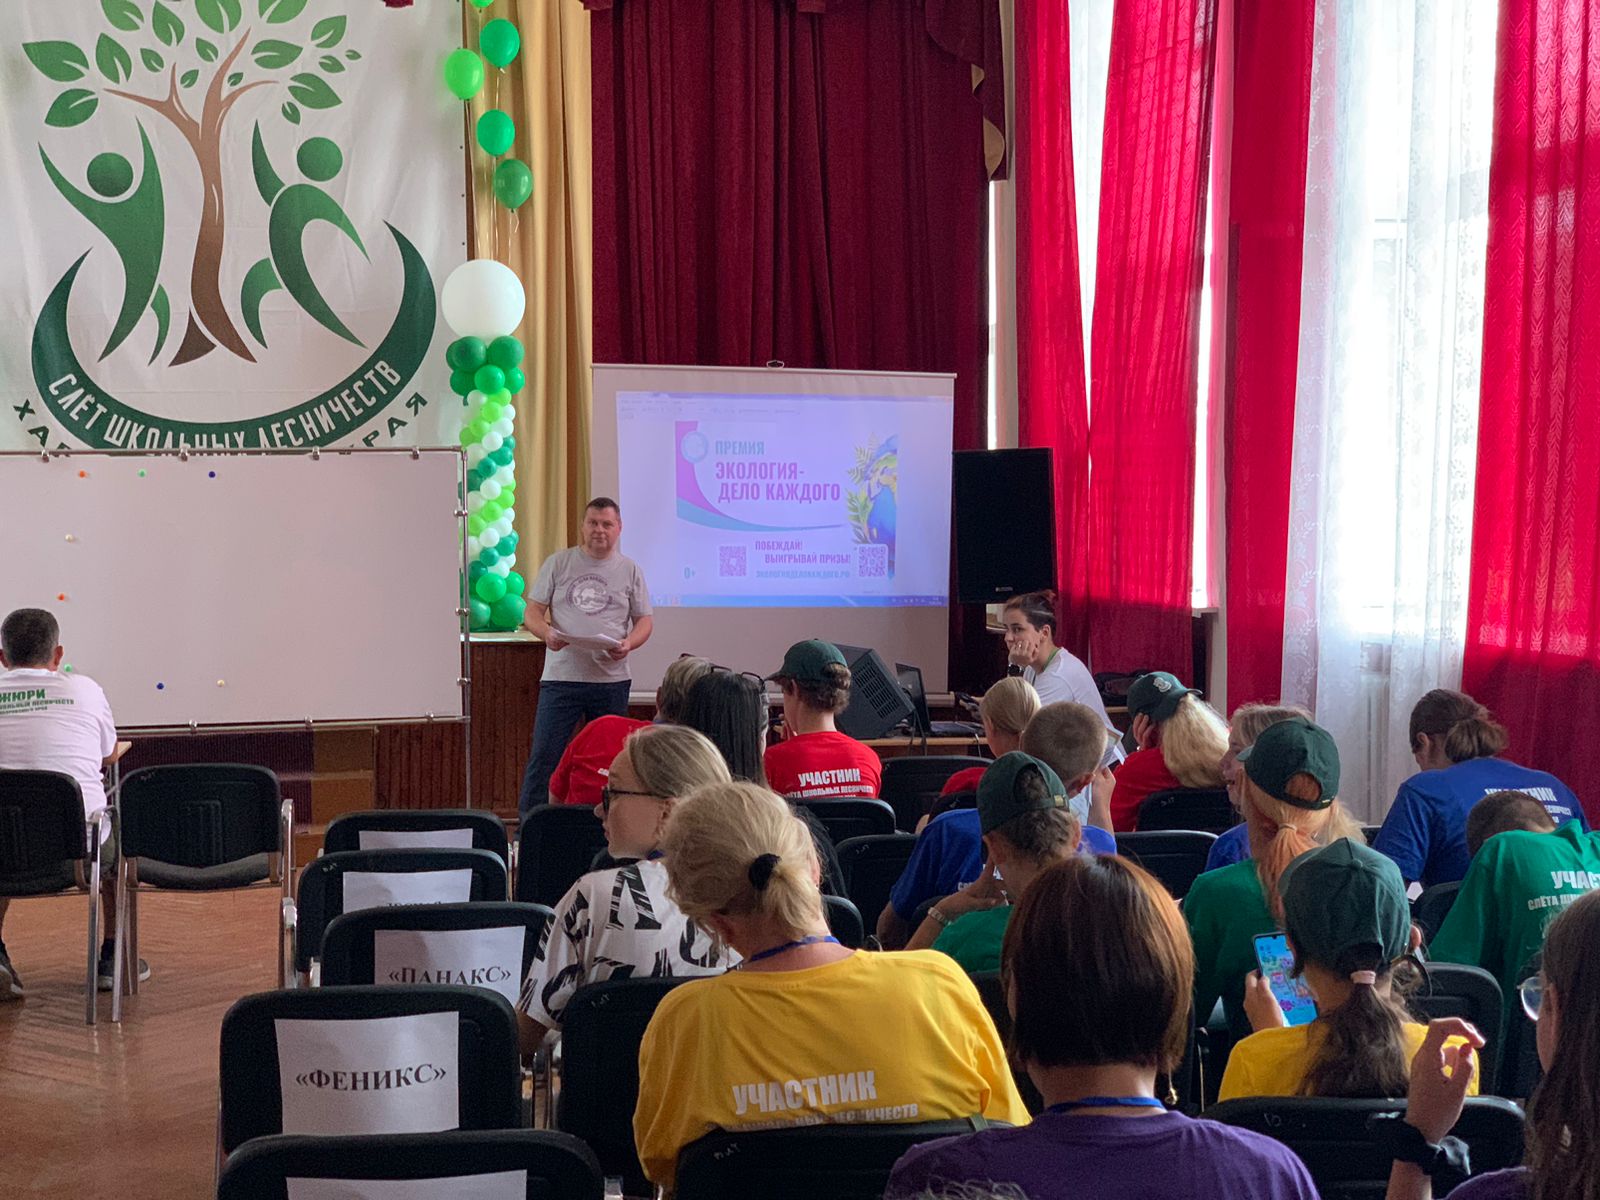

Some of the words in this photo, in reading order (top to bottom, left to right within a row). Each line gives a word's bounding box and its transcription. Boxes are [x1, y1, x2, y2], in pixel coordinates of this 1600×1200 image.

[103, 413, 246, 456] ШКОЛЬНЫХ
[258, 360, 402, 456] ЛЕСНИЧЕСТВ
[715, 440, 765, 455] ПРЕМИЯ
[716, 462, 805, 480] ЭКОЛОГИЯ-
[718, 482, 760, 504] ДЕЛО
[766, 483, 840, 504] КАЖДОГО
[765, 552, 817, 564] ВЫИГРЫВАЙ
[798, 768, 861, 787] УЧАСТНИК
[389, 966, 511, 985] «ПАНАКС»
[296, 1064, 446, 1091] «ФЕНИКС»
[732, 1071, 877, 1114] УЧАСТНИК
